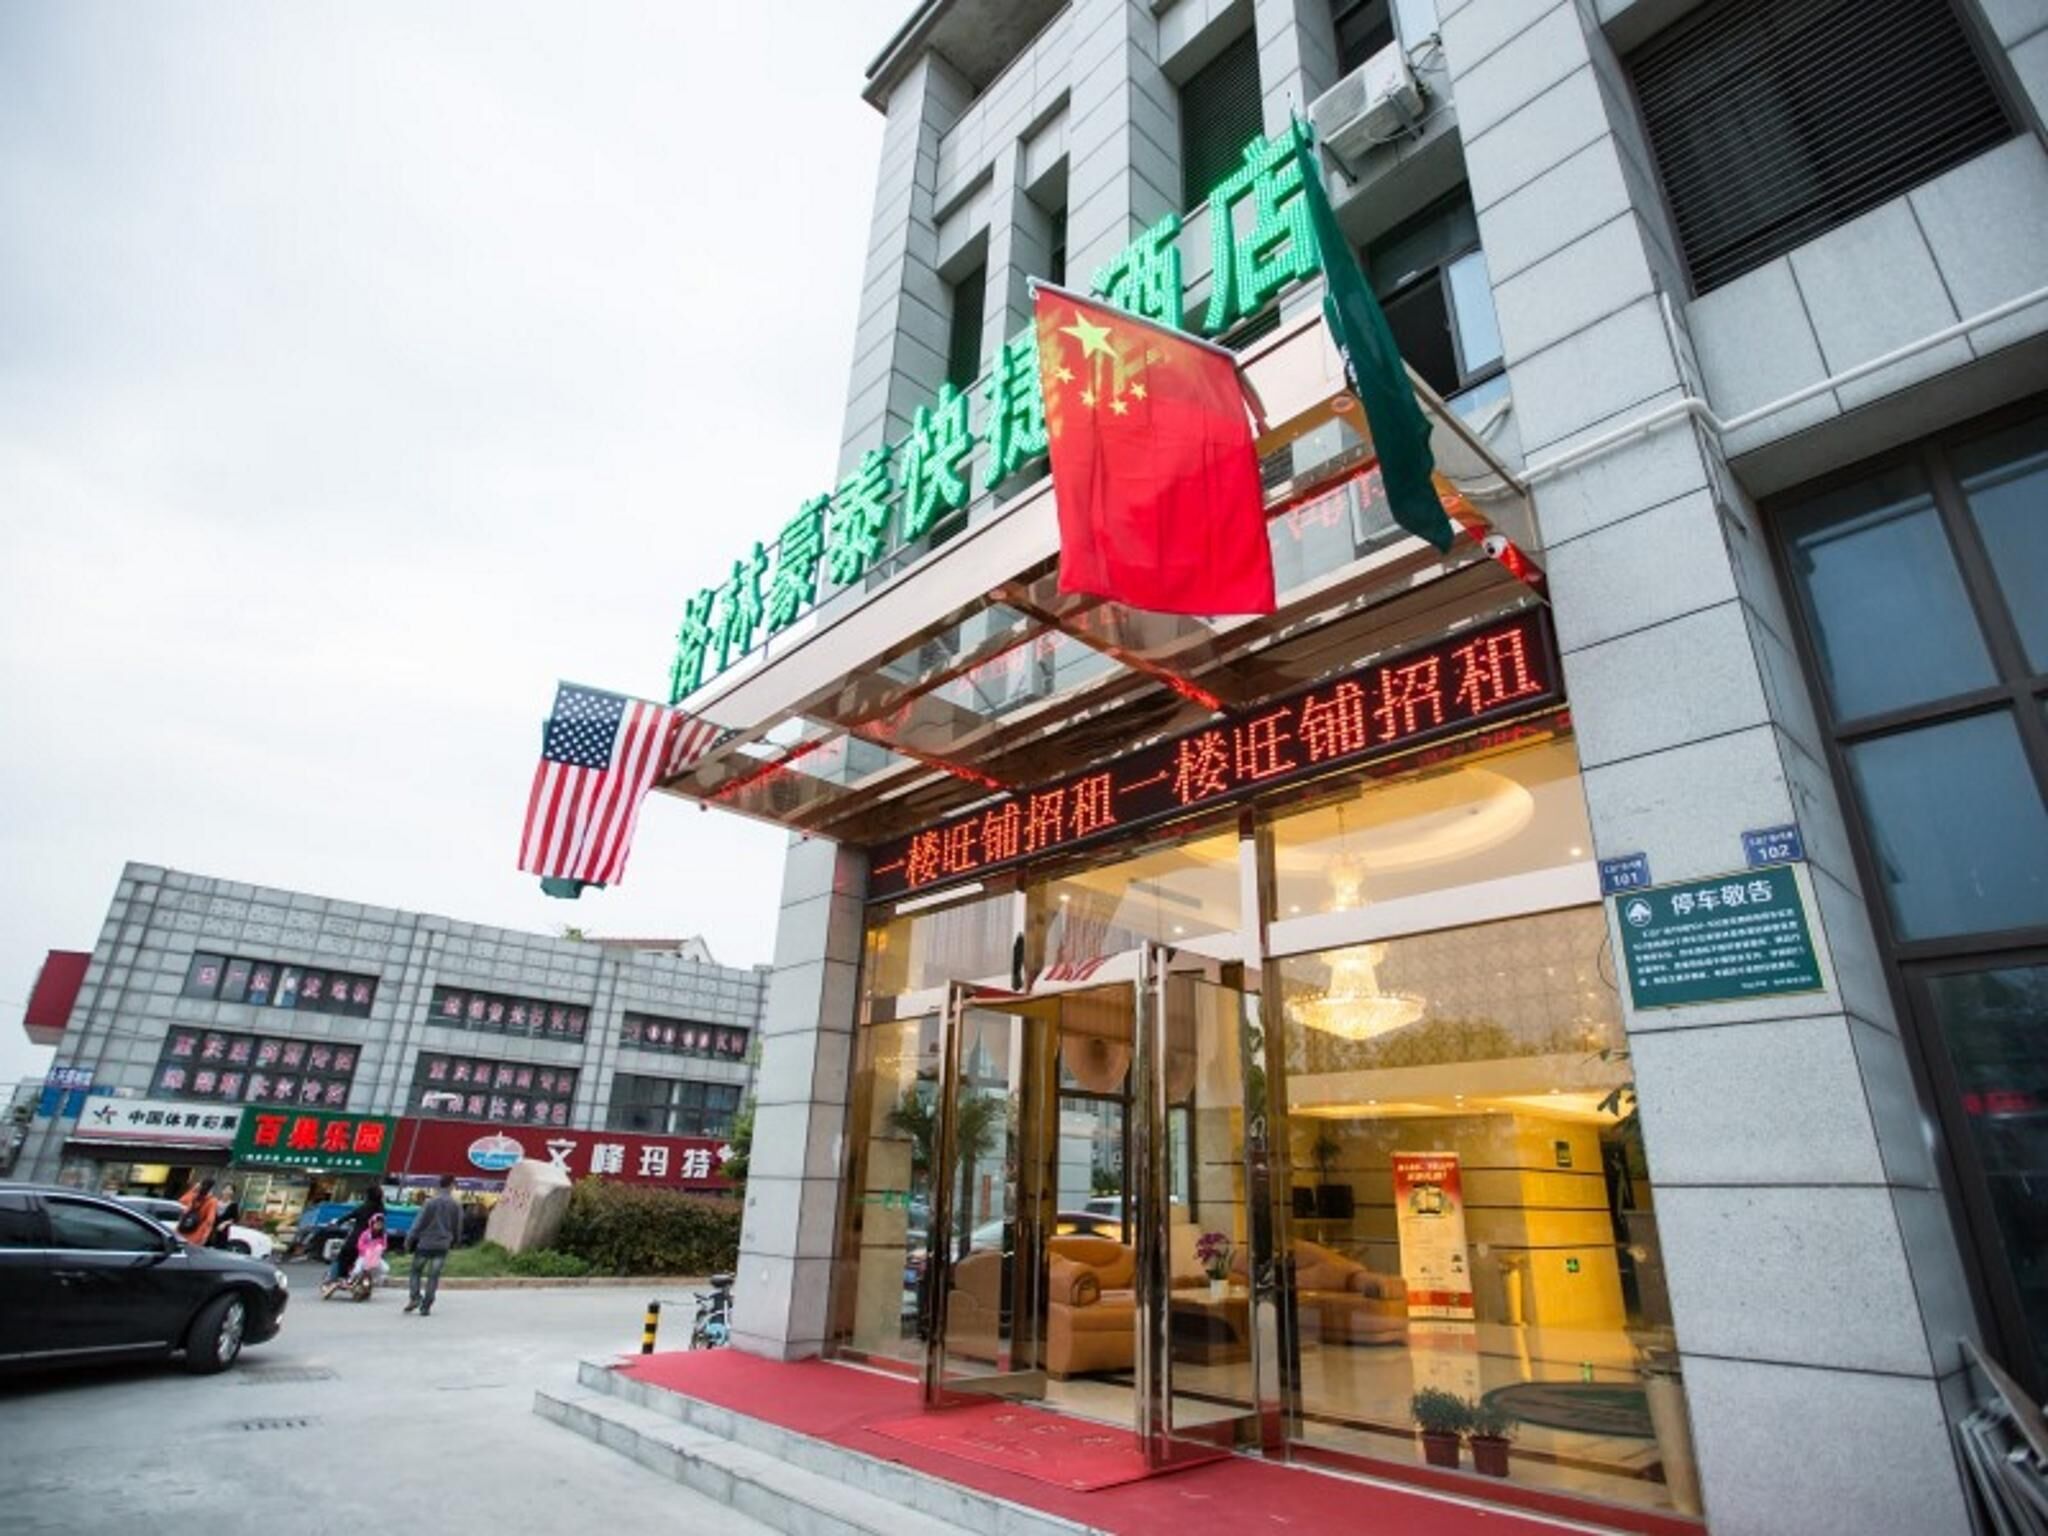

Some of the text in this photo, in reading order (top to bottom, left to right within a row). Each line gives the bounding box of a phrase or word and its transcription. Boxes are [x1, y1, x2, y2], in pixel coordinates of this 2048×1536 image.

[1757, 844, 1791, 861] 102
[1612, 872, 1639, 887] 101
[1671, 880, 1773, 916] 停车敬告
[127, 1109, 241, 1131] 中国体育彩票
